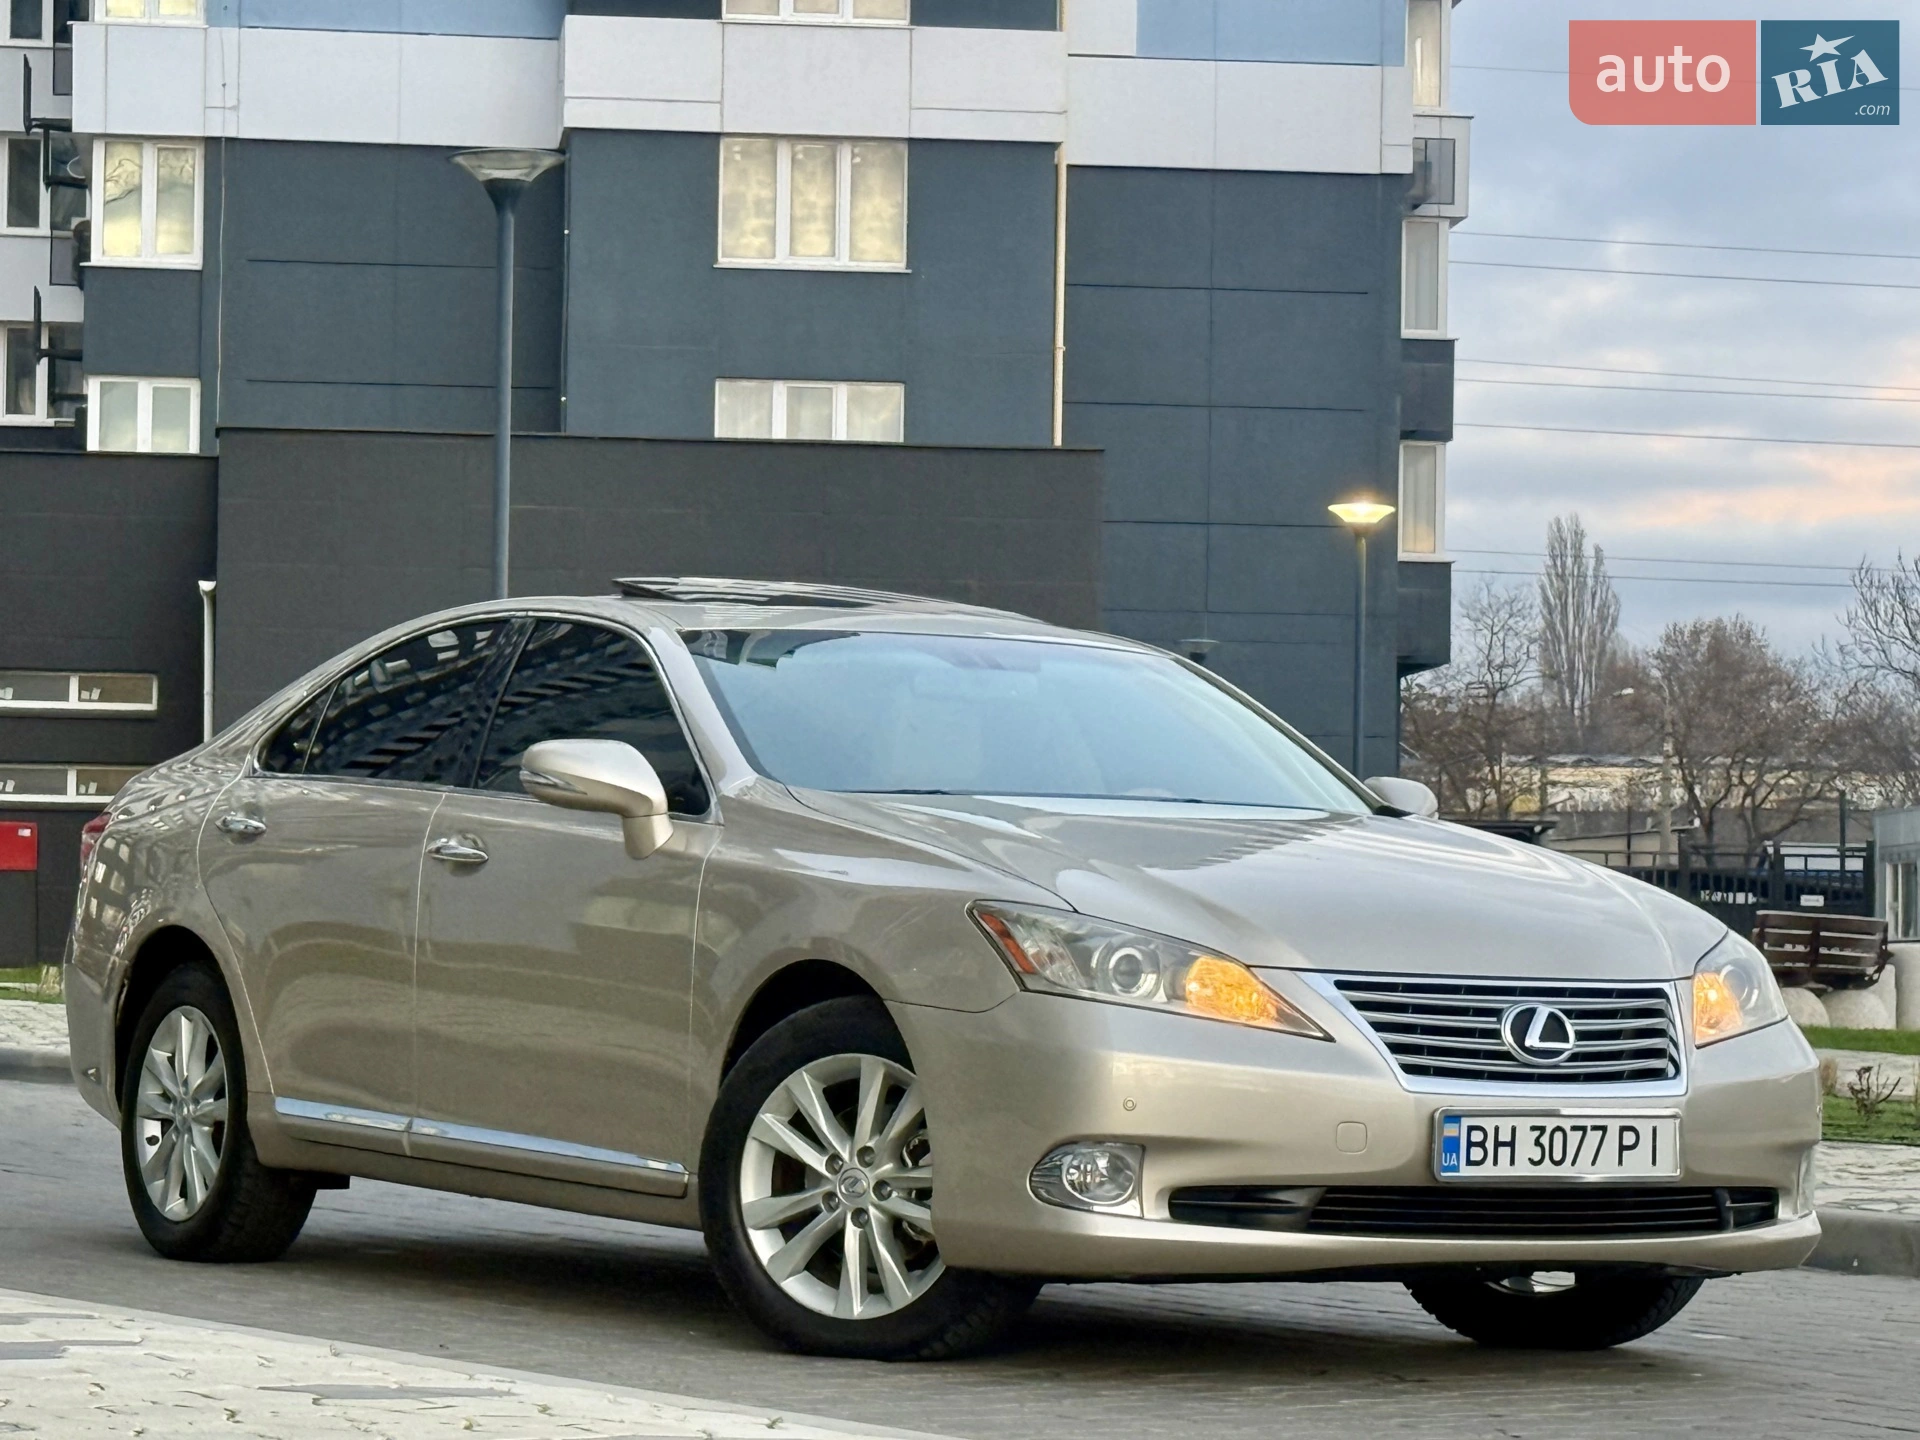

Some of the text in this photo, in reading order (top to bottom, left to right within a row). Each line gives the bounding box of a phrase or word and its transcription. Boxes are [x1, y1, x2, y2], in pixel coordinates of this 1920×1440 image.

[1442, 1152, 1458, 1167] UA
[1465, 1125, 1517, 1167] BH
[1528, 1125, 1608, 1167] 3077
